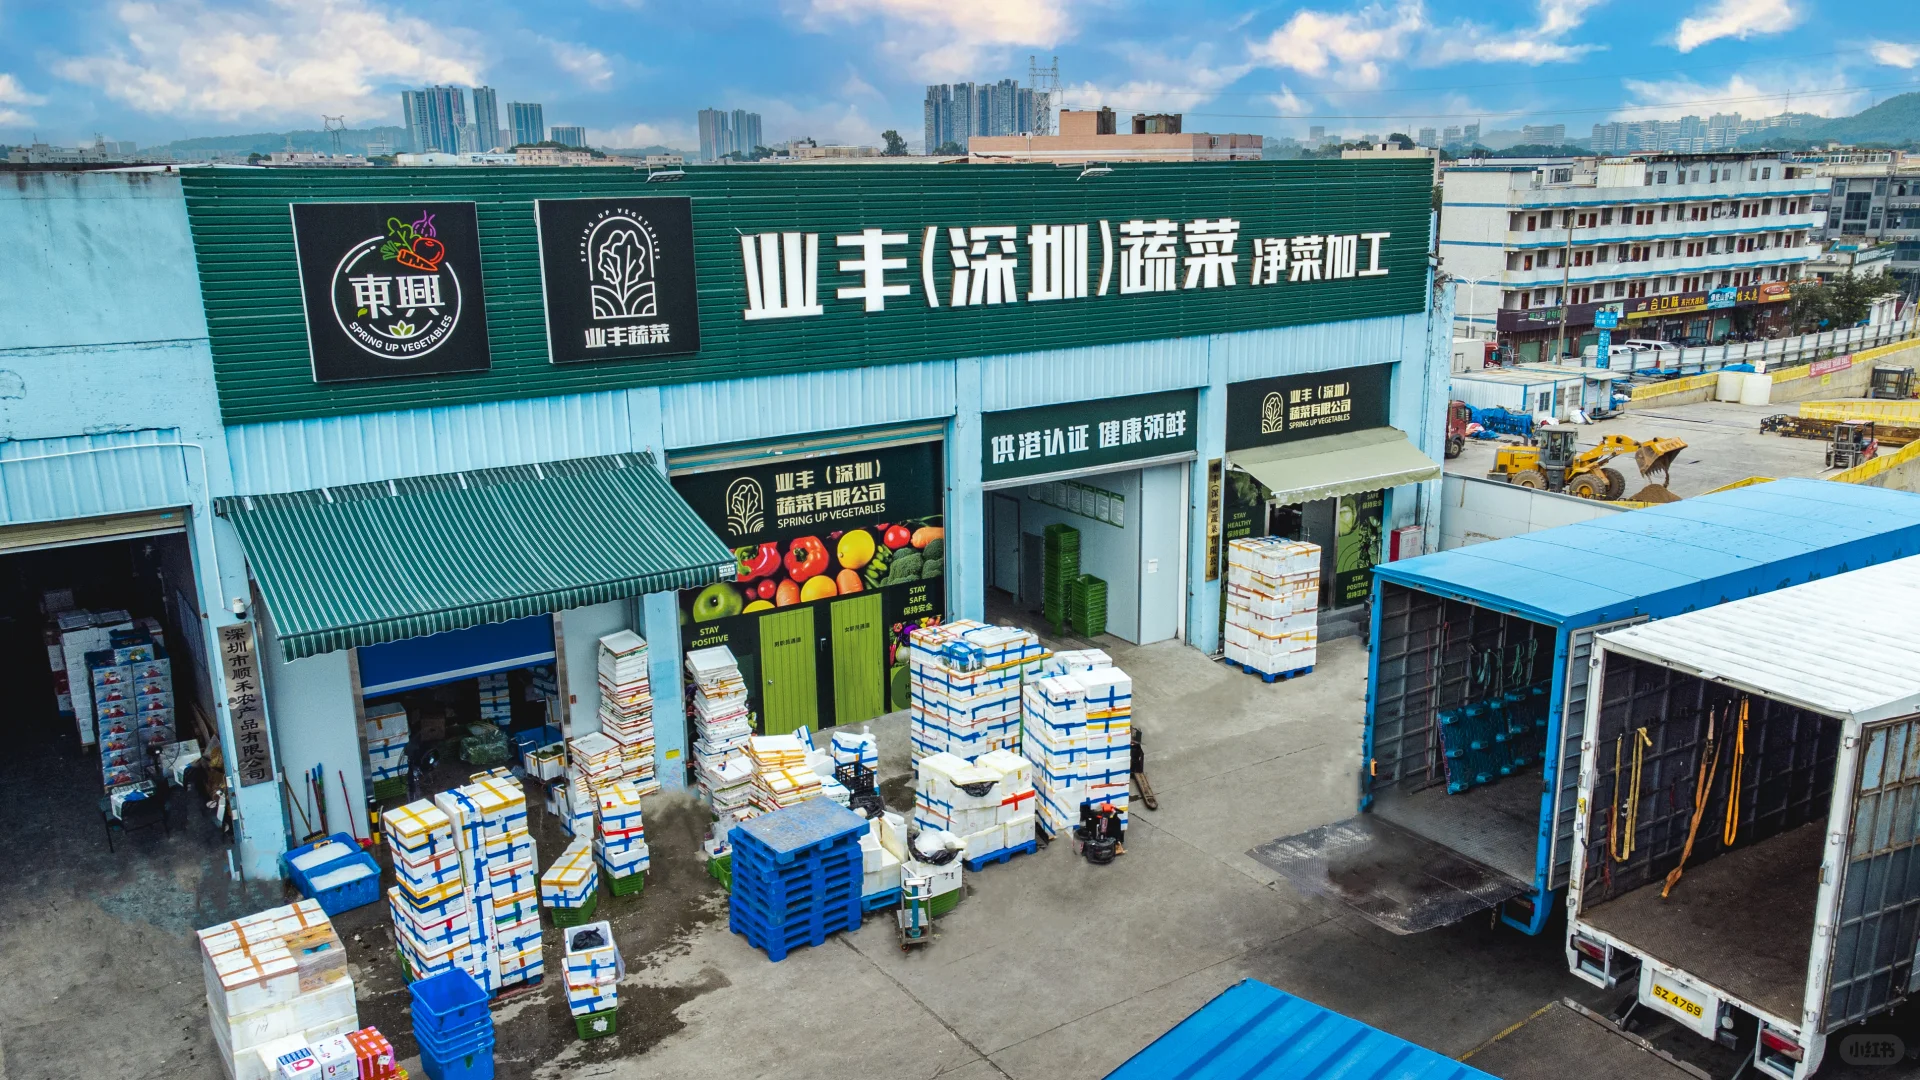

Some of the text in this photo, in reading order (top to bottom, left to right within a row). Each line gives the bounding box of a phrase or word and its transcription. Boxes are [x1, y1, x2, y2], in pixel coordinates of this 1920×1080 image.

[581, 207, 661, 263] SPRING UP VEGETABLES
[1251, 231, 1391, 286] 净菜加工
[348, 273, 445, 319] 東興
[349, 314, 453, 353] SPRING UP VEGETABLES
[584, 323, 671, 349] 业丰蔬菜
[1289, 381, 1350, 404] 业丰（深圳）
[1289, 398, 1351, 420] 蔬菜有限公司
[1288, 413, 1351, 430] SPRING UP VEGETABLES
[991, 410, 1187, 464] 供港认证 健康领鲜
[775, 459, 881, 493] 业丰（深圳）
[776, 482, 886, 516] 蔬菜有限公司
[777, 502, 886, 529] SPRING UP VEGETABLES
[1227, 519, 1252, 529] HEALTHY
[1233, 512, 1247, 520] STAY
[909, 585, 926, 595] STAY
[1346, 580, 1369, 591] POSITIVE
[1351, 574, 1364, 583] STAY
[903, 602, 933, 616] 保持安全
[909, 594, 927, 604] SAFE
[691, 633, 729, 648] POSITIVE
[699, 625, 720, 636] STAY
[224, 627, 266, 780] 深圳市顺禾农产品有限公司
[1654, 985, 1702, 1017] SZ 4769
